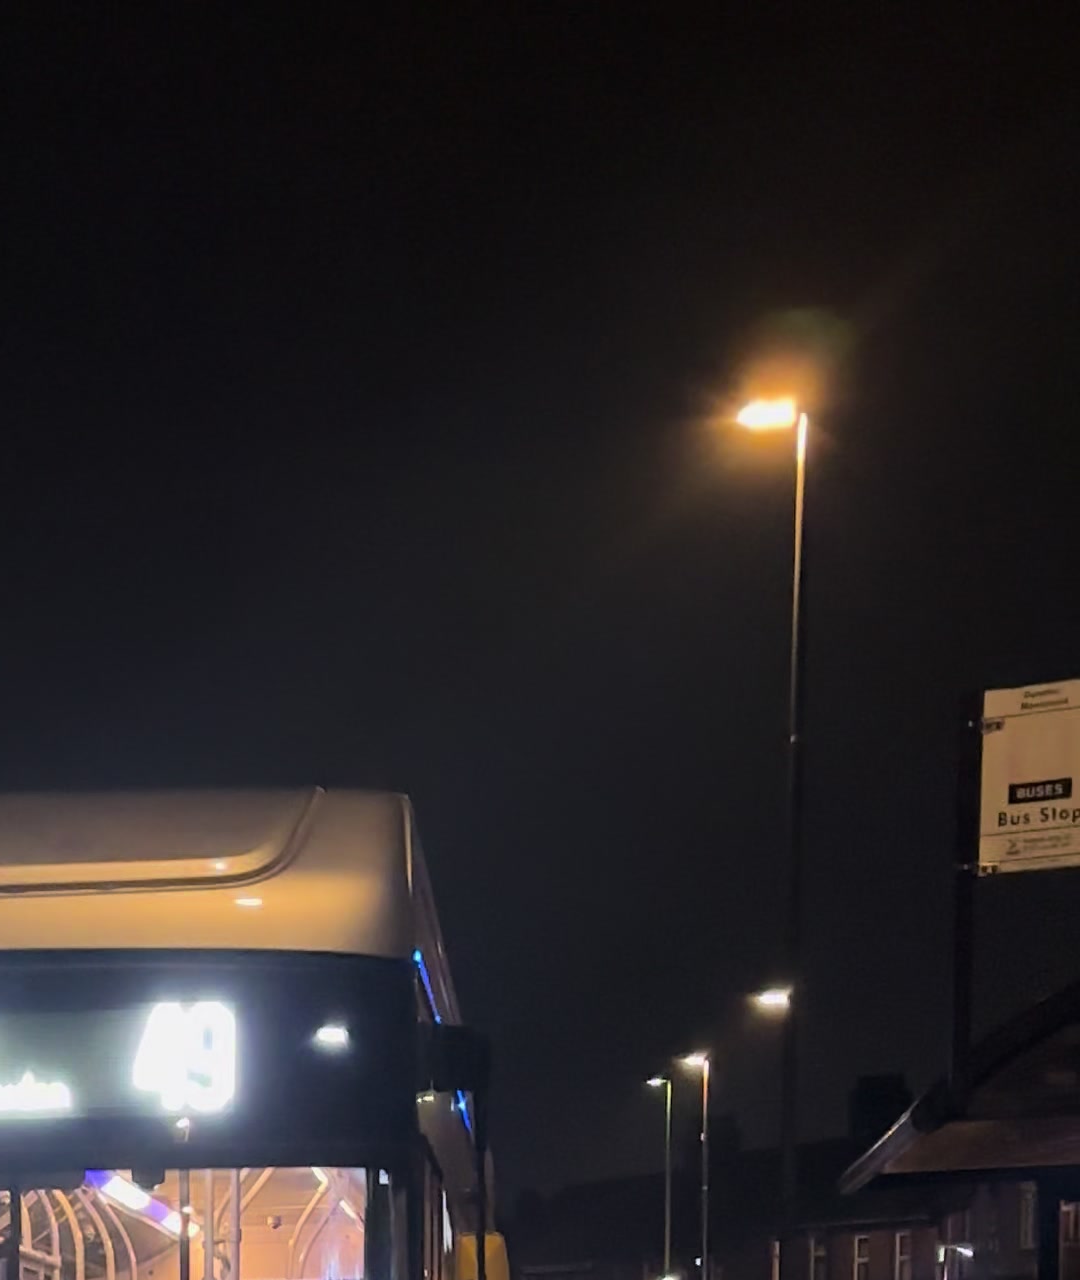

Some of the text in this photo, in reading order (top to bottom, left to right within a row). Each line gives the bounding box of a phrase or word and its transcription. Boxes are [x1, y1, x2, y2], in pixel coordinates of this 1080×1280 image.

[1016, 783, 1063, 799] BUSES
[998, 811, 1031, 827] Bus
[131, 1000, 236, 1111] 49
